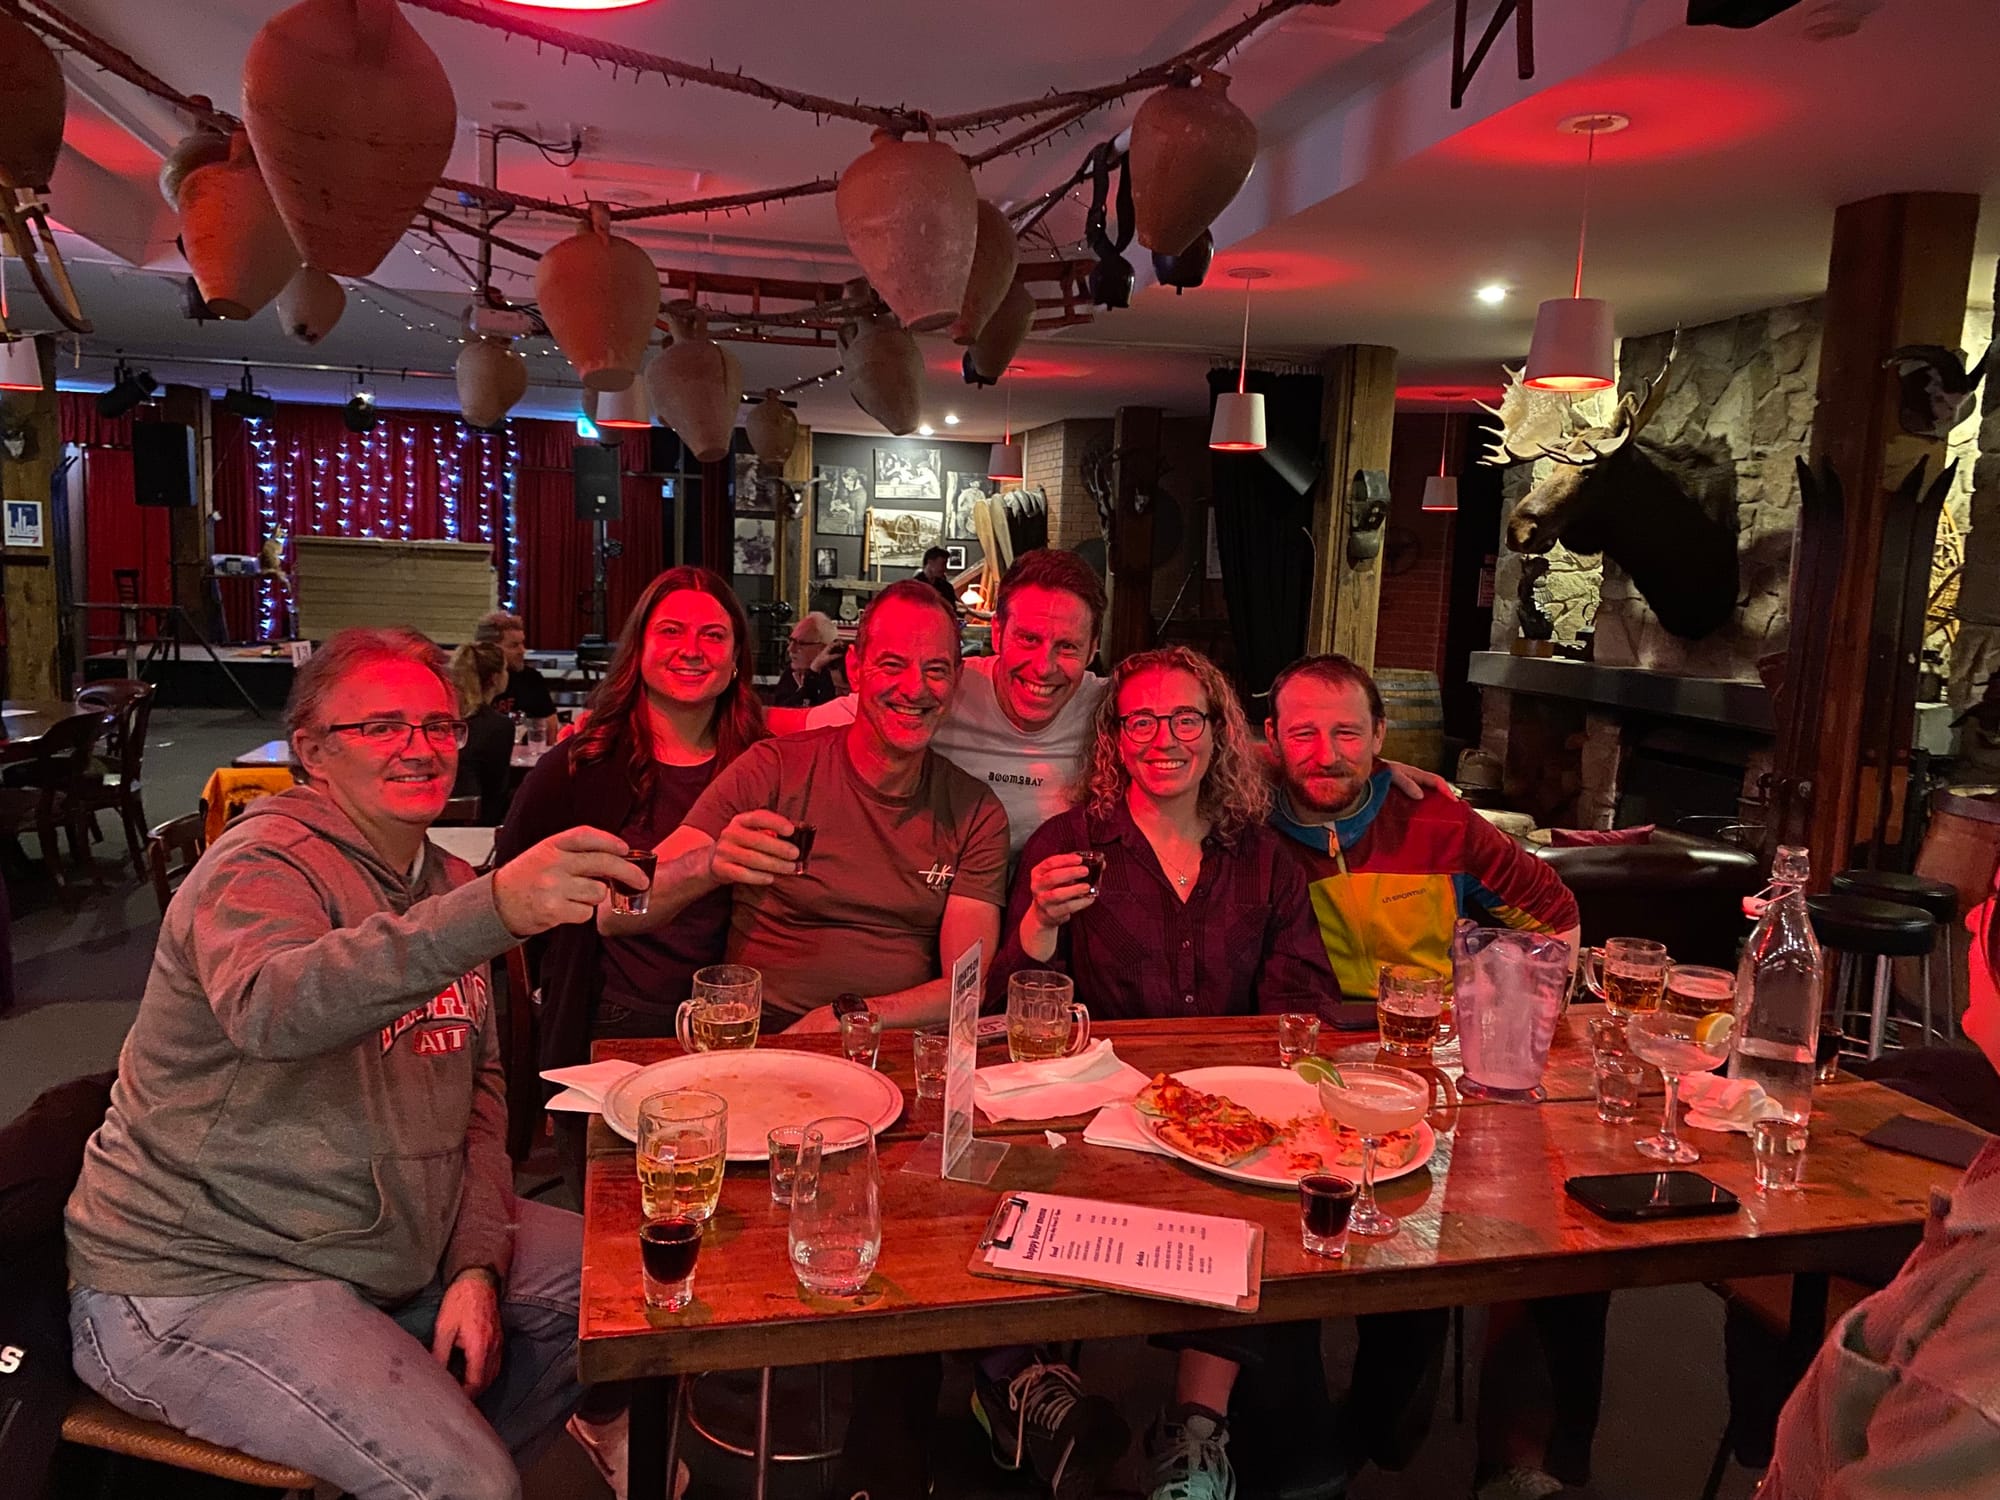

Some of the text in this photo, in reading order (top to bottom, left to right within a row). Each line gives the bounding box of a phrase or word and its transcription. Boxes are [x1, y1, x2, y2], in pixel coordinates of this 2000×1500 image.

[1022, 1207, 1047, 1260] happy hour menu
